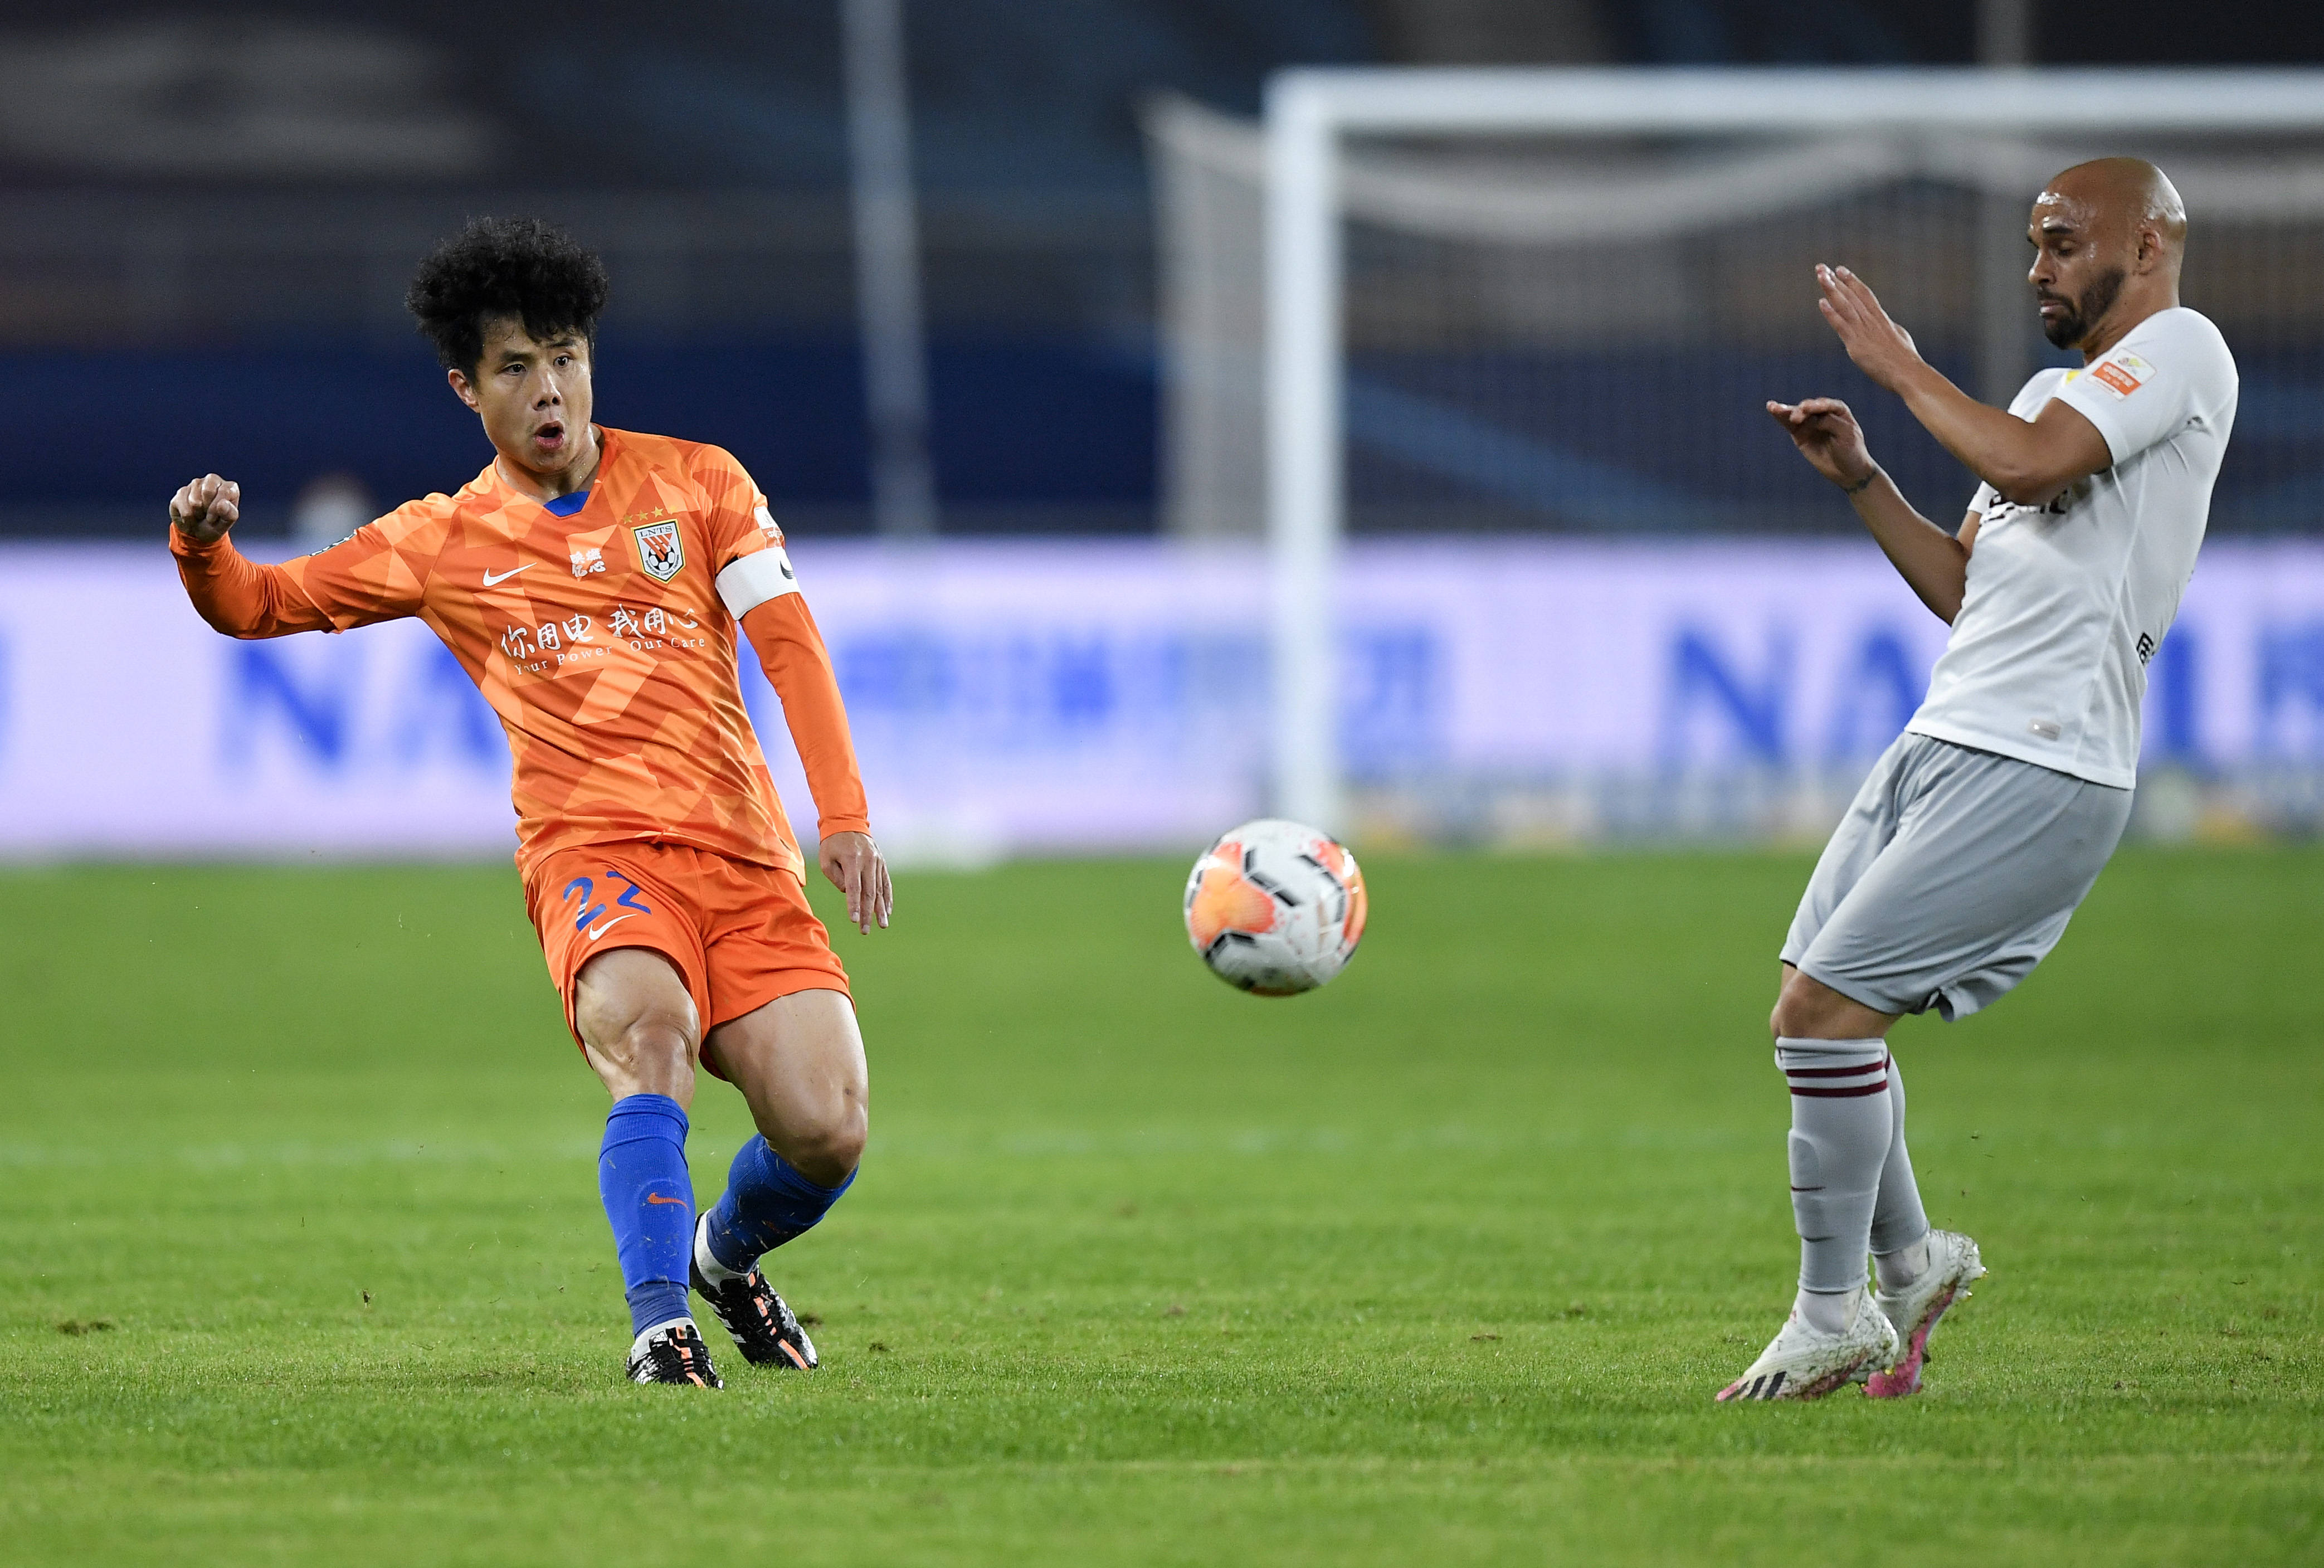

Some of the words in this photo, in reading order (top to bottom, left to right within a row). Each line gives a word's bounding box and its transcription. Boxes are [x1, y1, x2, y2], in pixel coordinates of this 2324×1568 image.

[640, 525, 673, 537] LNTS
[501, 613, 594, 660] 你用电
[607, 603, 699, 639] 我用心
[514, 659, 548, 675] Your
[556, 645, 612, 666] Power
[630, 640, 663, 652] Our
[670, 637, 705, 649] Care
[563, 870, 652, 932] 22
